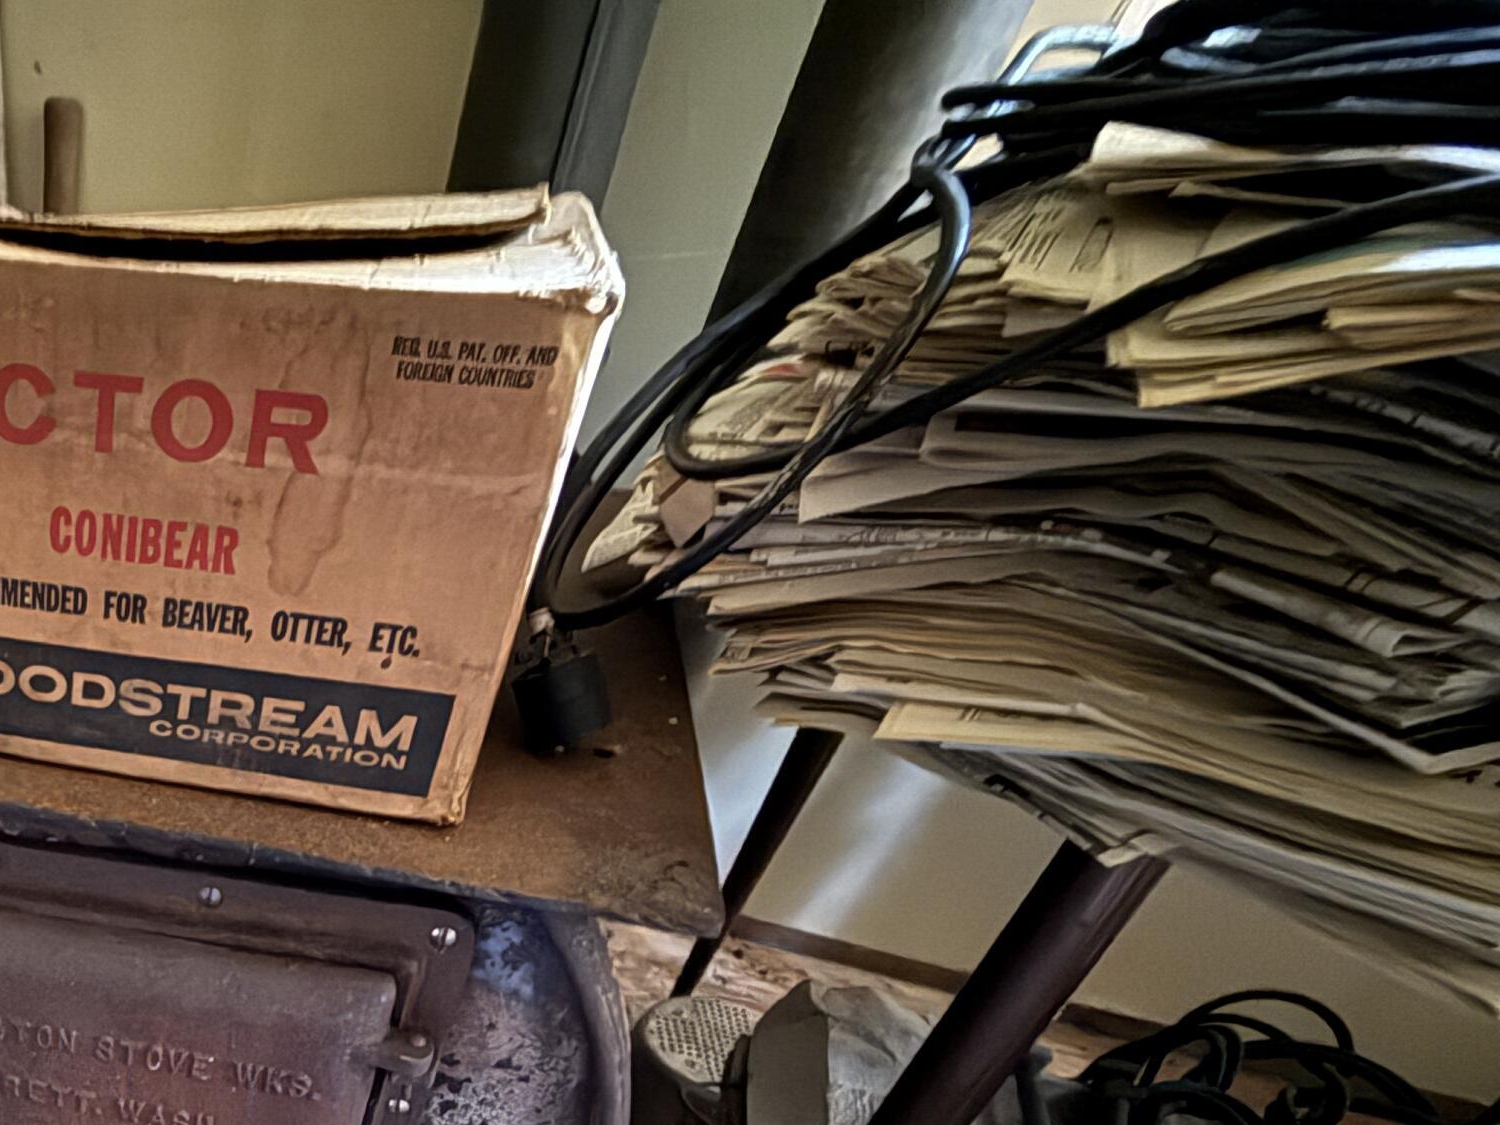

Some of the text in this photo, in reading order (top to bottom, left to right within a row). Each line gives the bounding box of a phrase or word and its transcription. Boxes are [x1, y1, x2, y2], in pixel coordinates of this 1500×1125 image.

[396, 360, 537, 389] FOREIGN COUNTRIES
[458, 341, 486, 363] PAT.
[493, 344, 521, 364] OFF.
[526, 345, 560, 366] AND
[49, 505, 239, 576] CONIBEAR
[103, 590, 147, 624] FOR
[162, 598, 253, 643] BEAVER,
[270, 610, 352, 653] OTTER,
[369, 622, 421, 657] ETC.
[148, 718, 407, 771] CORPORATION
[95, 1034, 216, 1081] STOVE
[232, 1059, 322, 1101] WKS.
